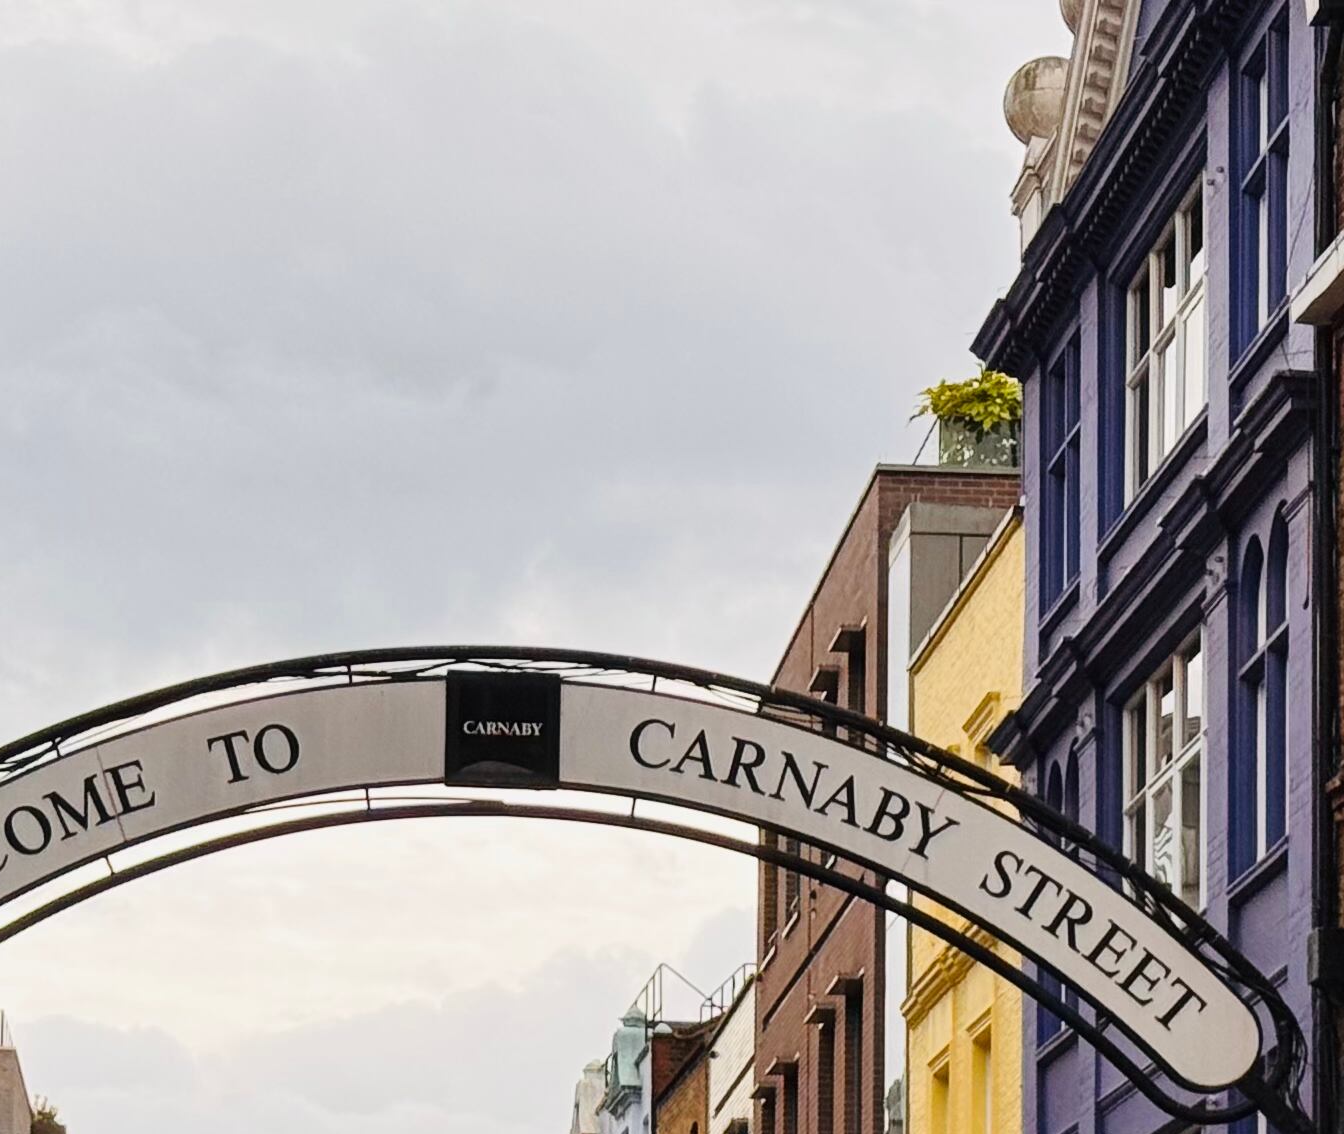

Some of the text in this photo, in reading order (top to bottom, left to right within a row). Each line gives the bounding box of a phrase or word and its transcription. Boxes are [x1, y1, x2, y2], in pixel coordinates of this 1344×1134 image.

[463, 720, 543, 736] CARNABY
[206, 723, 300, 785] TO
[629, 718, 960, 860] CARNABY
[978, 850, 1207, 1032] STREET
